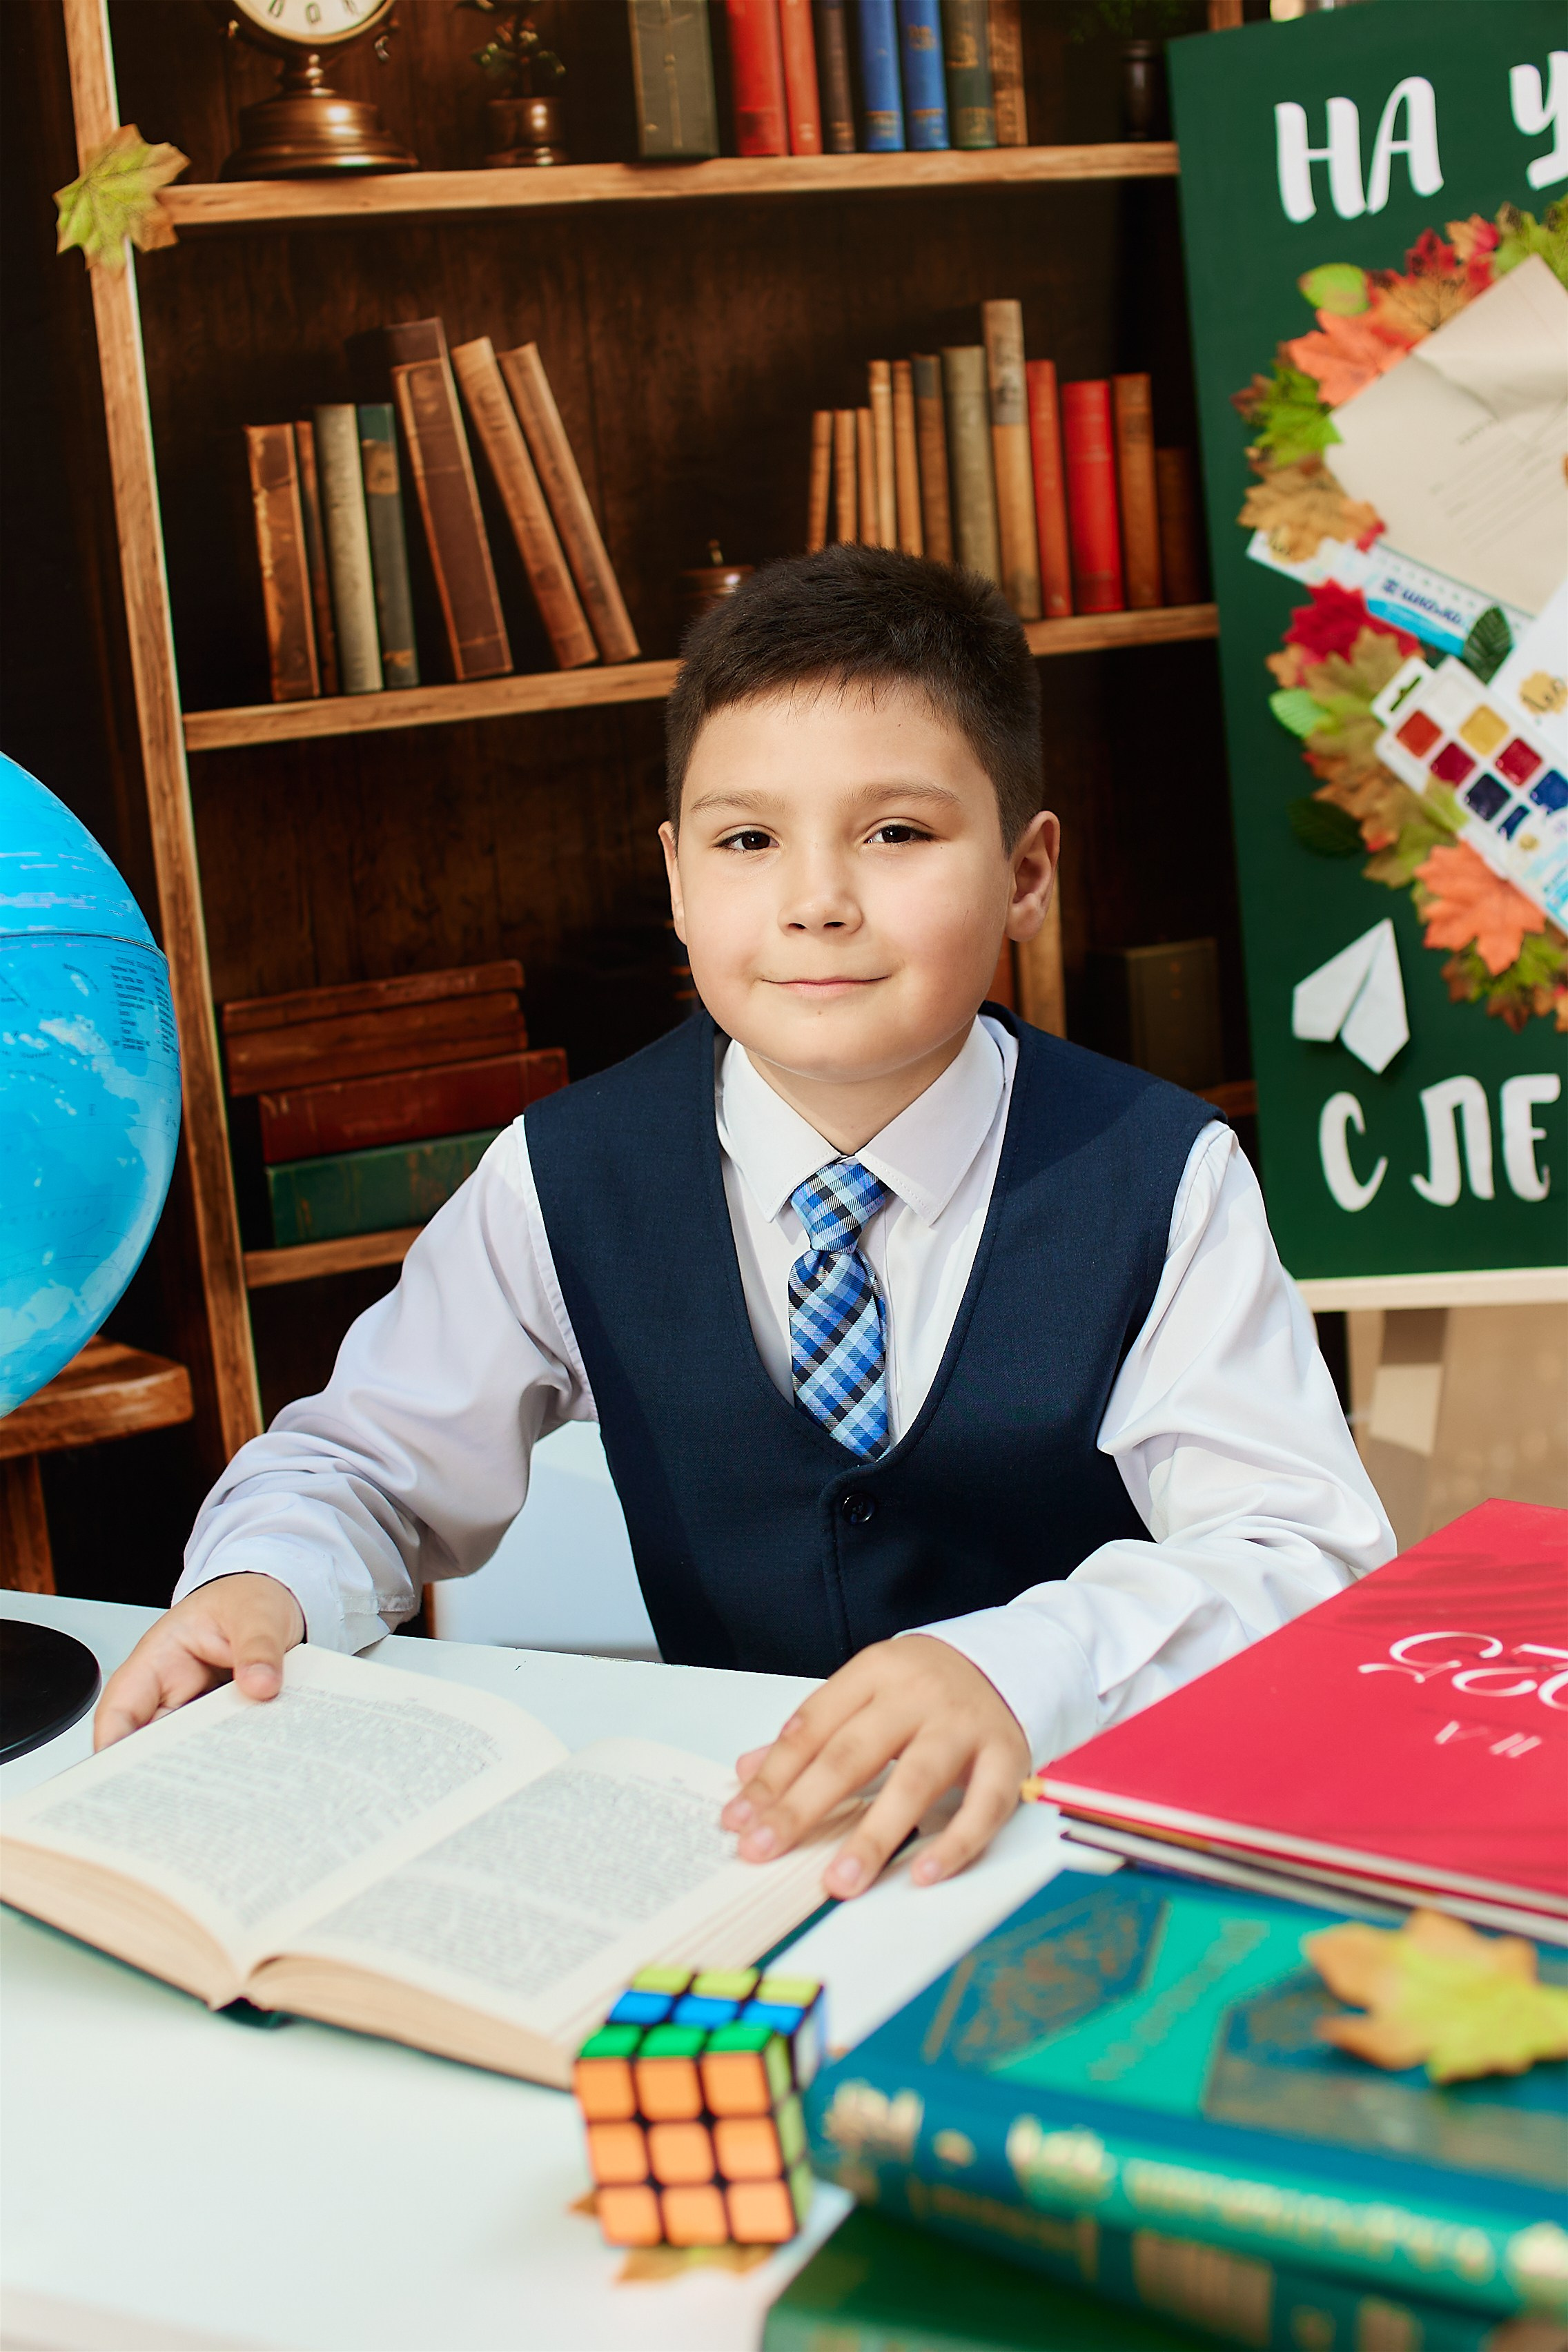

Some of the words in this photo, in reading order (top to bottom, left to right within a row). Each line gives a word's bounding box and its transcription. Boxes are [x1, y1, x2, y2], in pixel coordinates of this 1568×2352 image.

[1275, 75, 1444, 223] НА
[1319, 1091, 1389, 1212] С
[1411, 1072, 1561, 1207] ЛЕ
